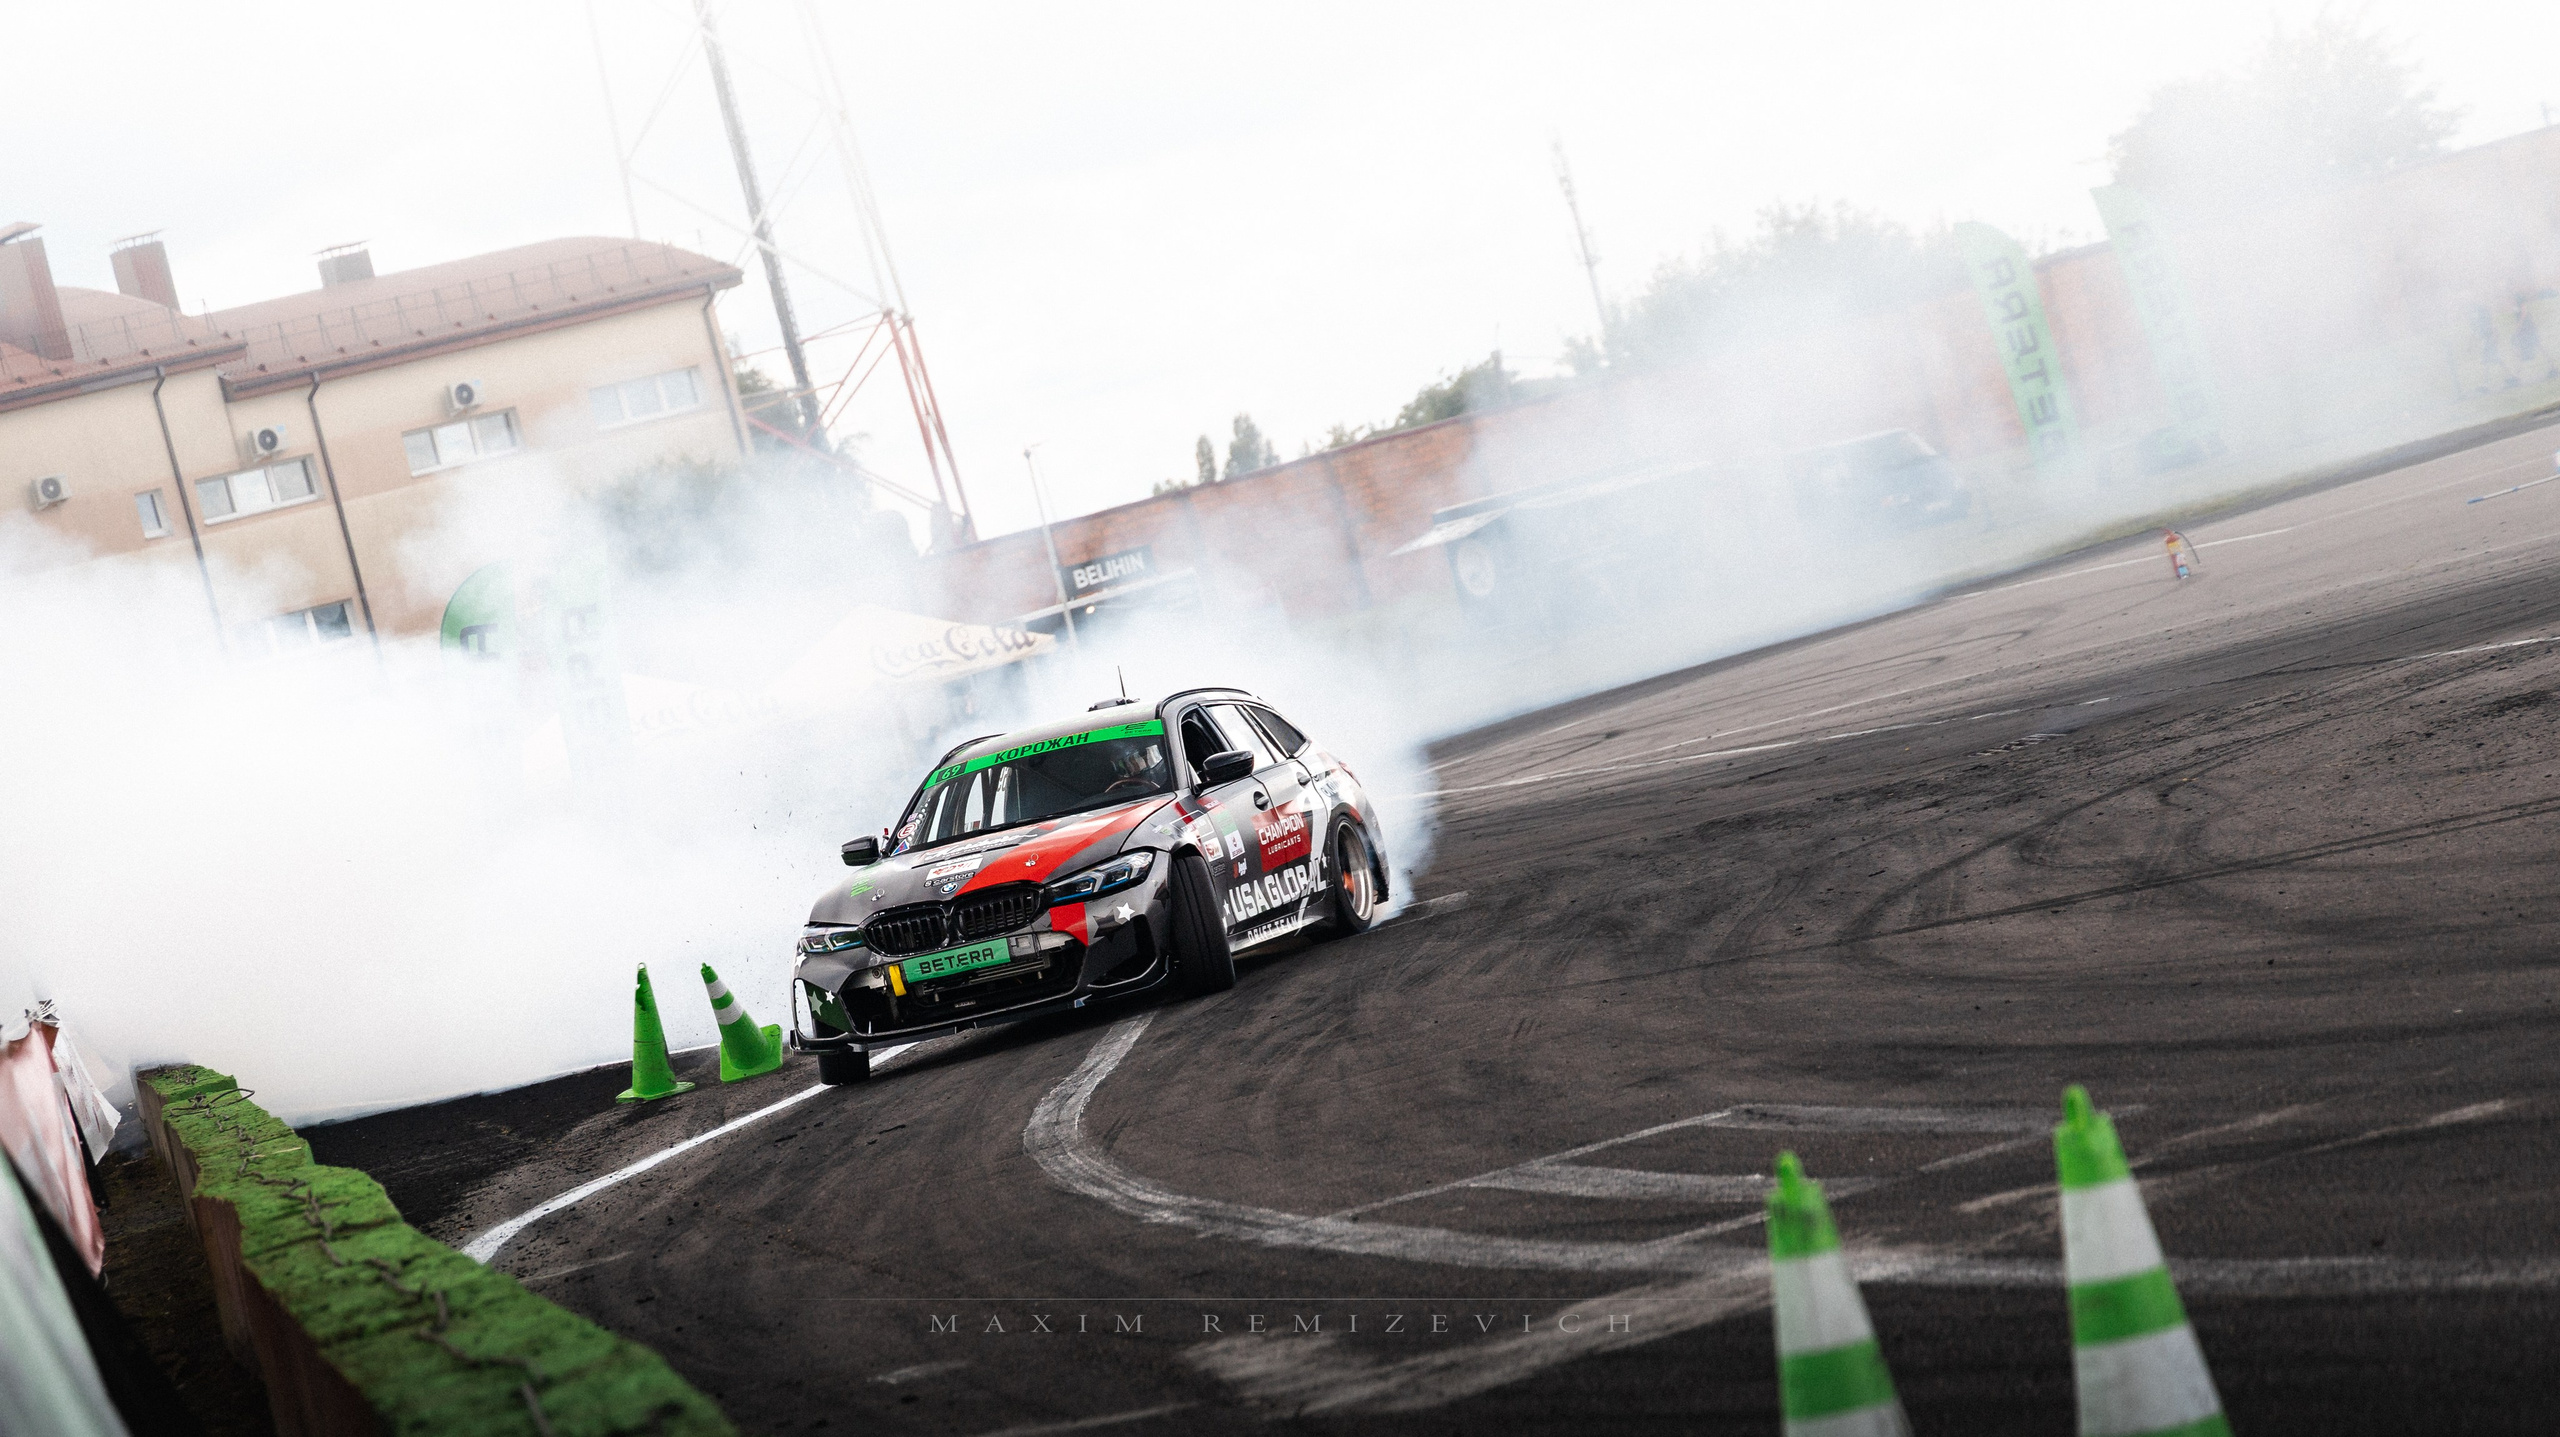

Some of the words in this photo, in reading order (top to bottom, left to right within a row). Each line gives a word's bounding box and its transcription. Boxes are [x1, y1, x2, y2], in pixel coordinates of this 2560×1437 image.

[994, 732, 1090, 764] КОРОЖАН
[940, 765, 960, 780] 69
[1258, 812, 1305, 846] CHAMPION
[1267, 834, 1302, 855] LUBRICANTS
